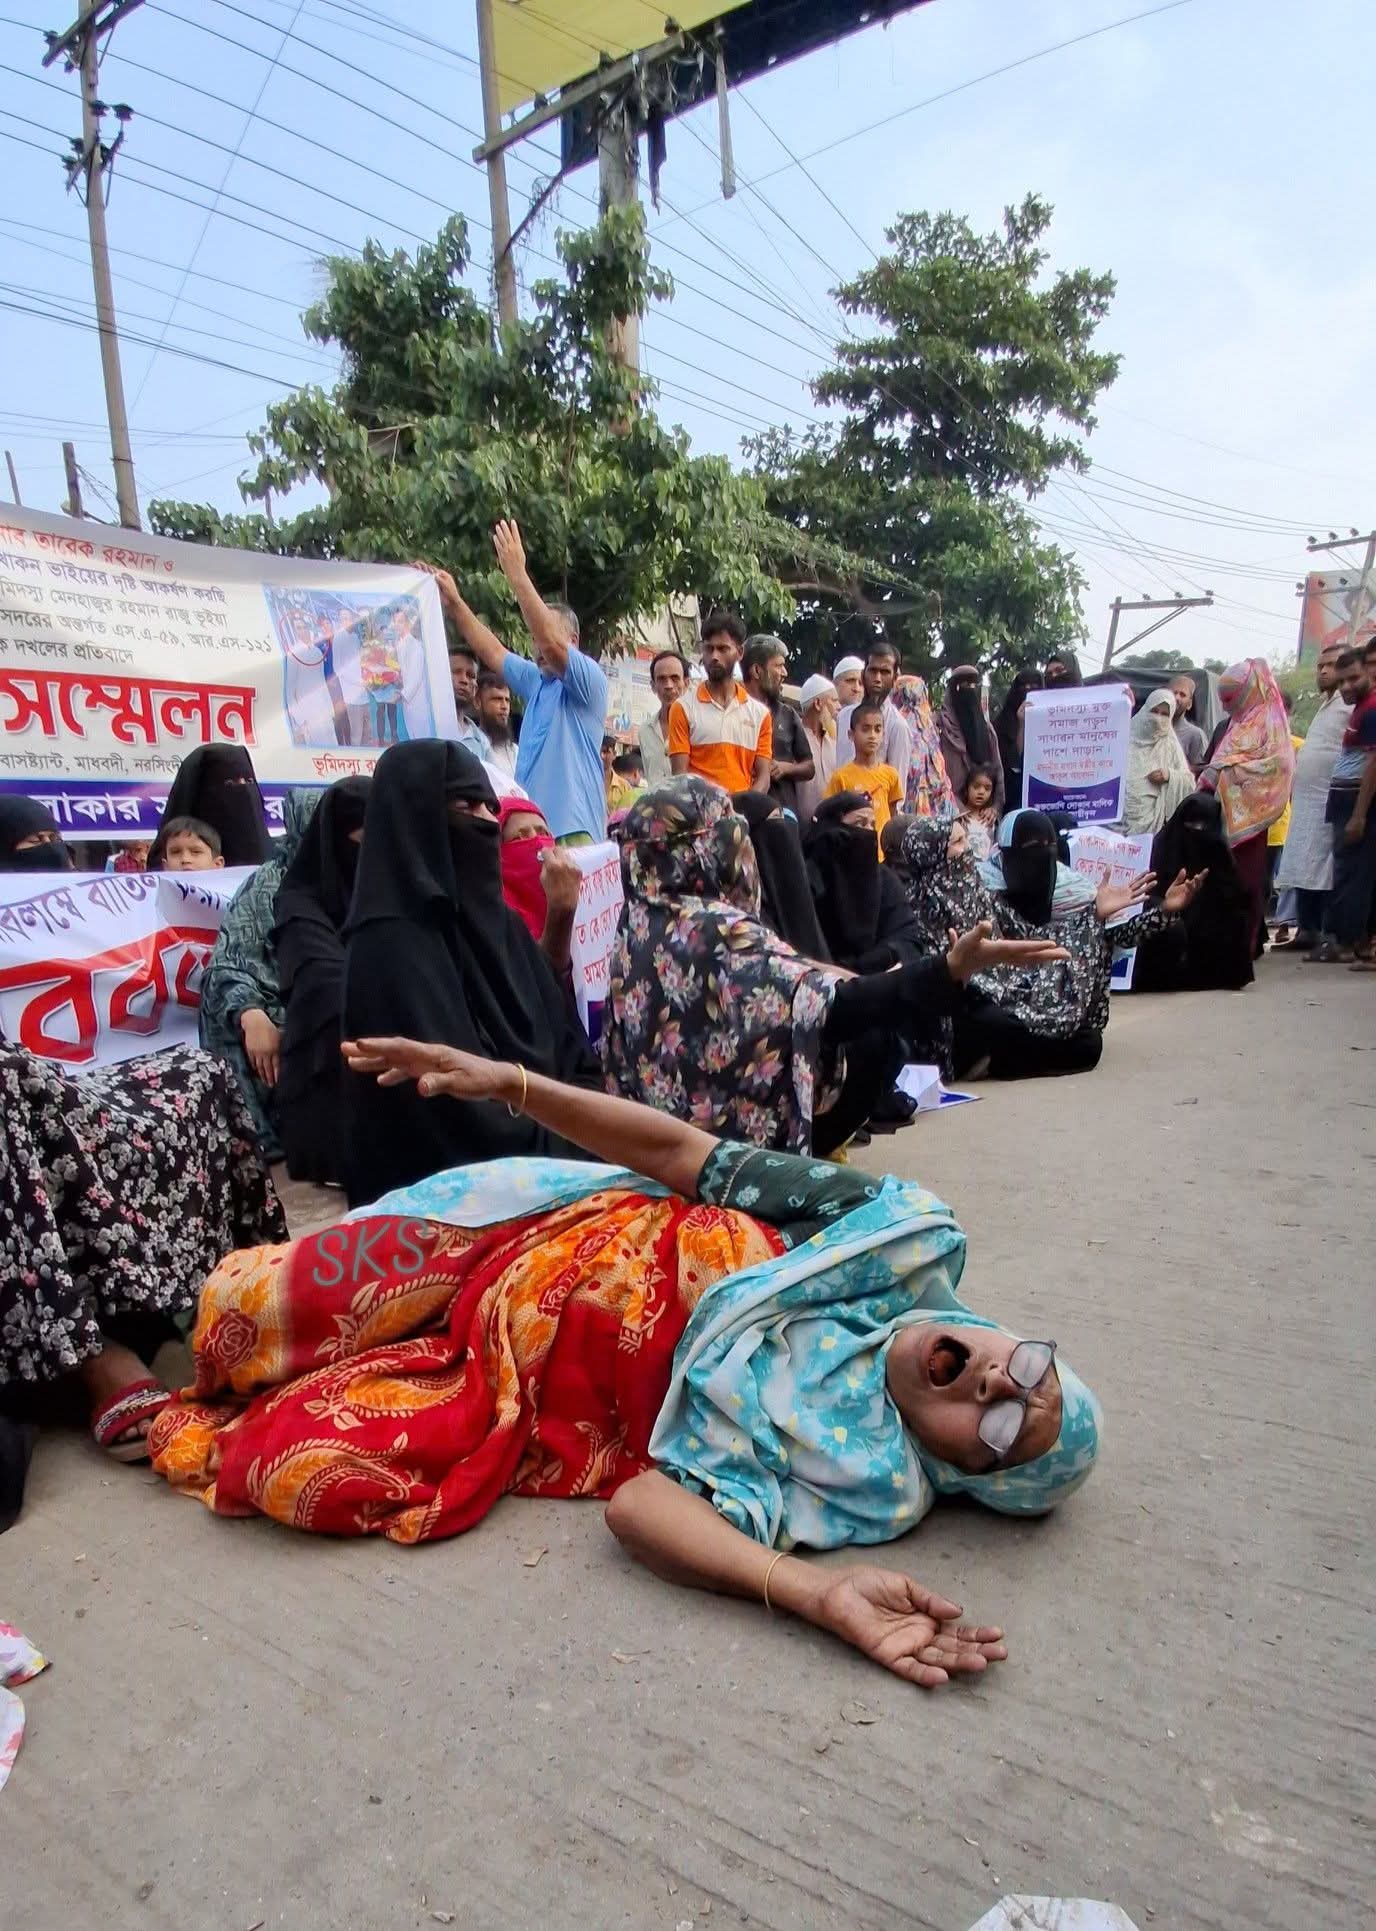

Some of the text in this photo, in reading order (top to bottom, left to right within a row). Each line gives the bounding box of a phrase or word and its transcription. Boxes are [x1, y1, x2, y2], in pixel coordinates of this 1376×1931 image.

[101, 544, 161, 573] রহমান
[163, 560, 175, 572] ও
[112, 572, 137, 595] দৃষ্টি
[117, 600, 160, 619] রহমান
[14, 638, 69, 661] দখলের
[73, 641, 135, 665] প্রতিবাদে
[0, 668, 256, 745] সম্মেলন
[1048, 718, 1079, 729] সমাজ
